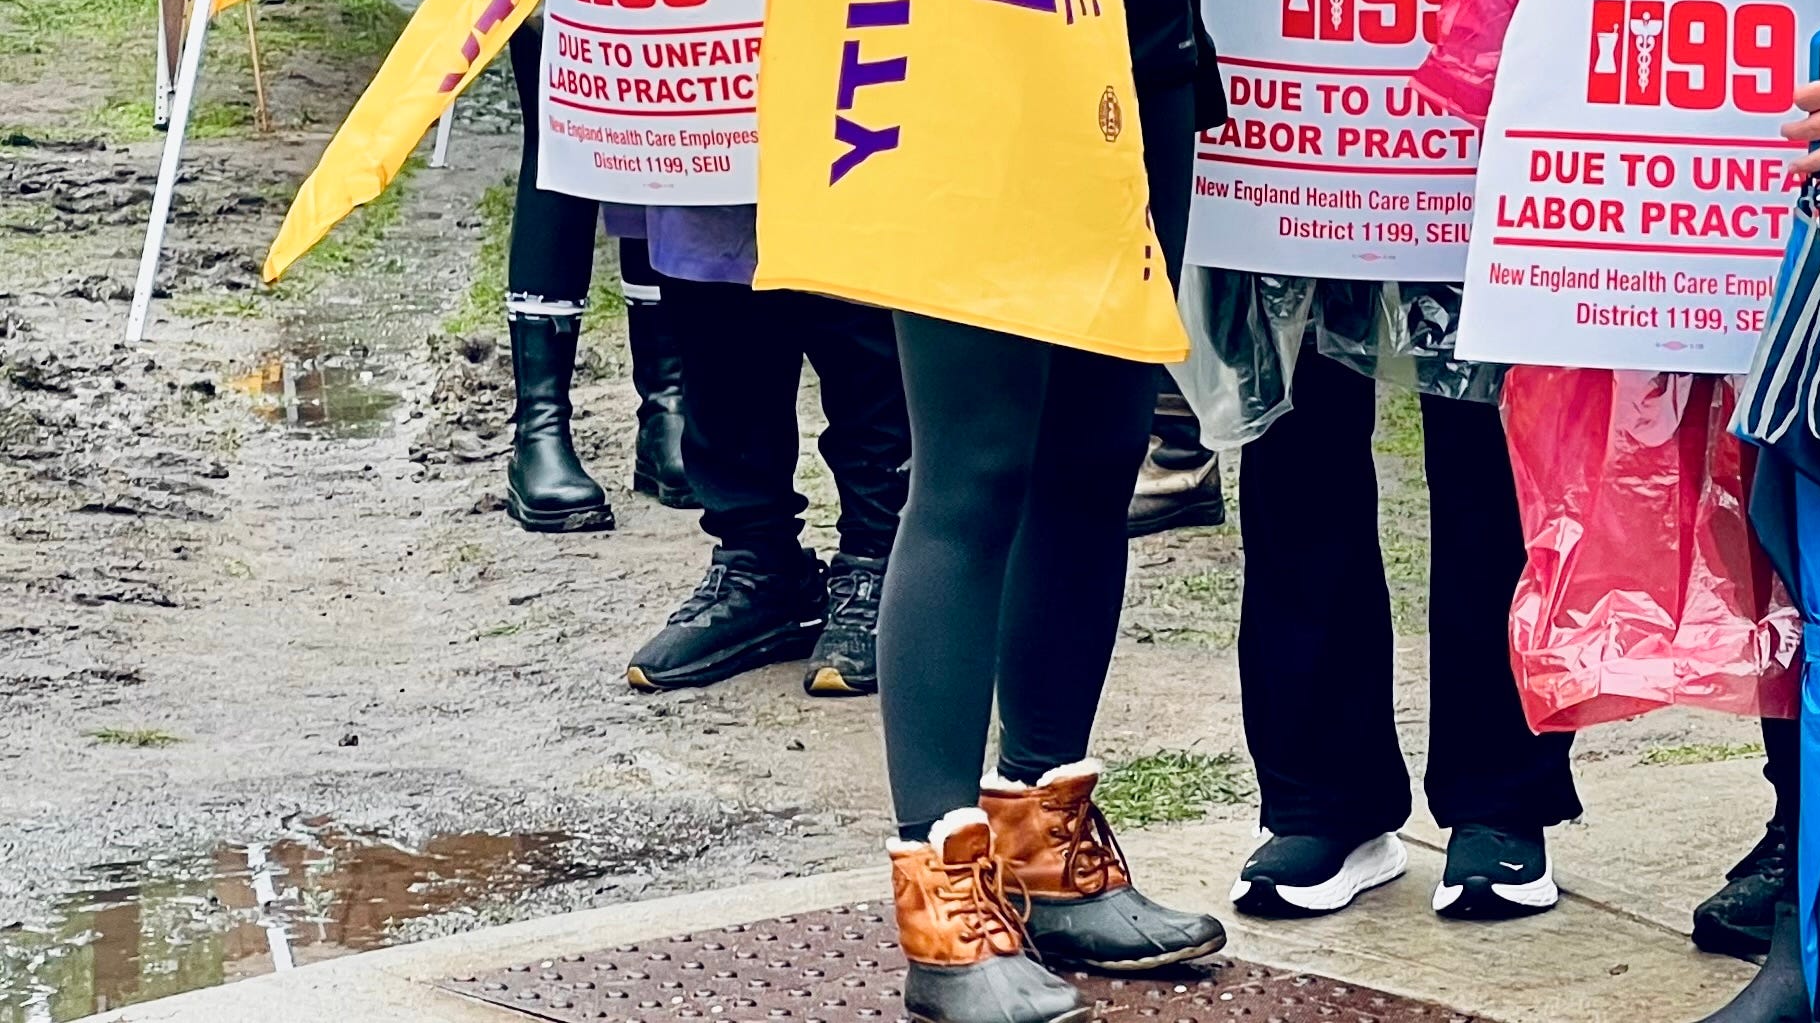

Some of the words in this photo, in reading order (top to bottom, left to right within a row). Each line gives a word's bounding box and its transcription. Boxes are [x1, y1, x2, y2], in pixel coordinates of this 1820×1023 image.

[560, 30, 594, 64] DUE
[599, 39, 633, 70] TO
[641, 36, 762, 69] UNFAIR
[1587, 0, 1796, 114] 1199
[549, 64, 610, 100] LABOR
[617, 74, 758, 104] PRACTIC
[1231, 75, 1302, 112] DUE
[1317, 84, 1369, 115] TO
[567, 119, 604, 144] England
[605, 126, 644, 146] Health
[646, 130, 677, 147] Care
[679, 129, 759, 150] Employees
[1338, 128, 1475, 160] PRACT
[594, 151, 642, 172] District
[647, 155, 688, 176] 1199,
[692, 156, 732, 174] SEIU
[1530, 150, 1605, 185] DUE
[1620, 154, 1675, 188] TO
[1693, 157, 1808, 192] UNFA
[1196, 176, 1229, 197] New
[1234, 180, 1300, 207] England
[1307, 187, 1362, 209] Health
[1369, 191, 1410, 211] Care
[1417, 192, 1472, 215] Emplo
[1280, 216, 1355, 241] District
[1362, 222, 1418, 245] 1199,
[1497, 195, 1625, 232] LABOR
[1642, 202, 1787, 239] PRACT
[1490, 263, 1525, 286] New
[1530, 265, 1600, 293] England
[1606, 270, 1667, 294] Health
[1674, 272, 1719, 295] Care
[1577, 302, 1659, 329] District
[1666, 307, 1728, 334] 1199,
[1736, 310, 1764, 332] SE
